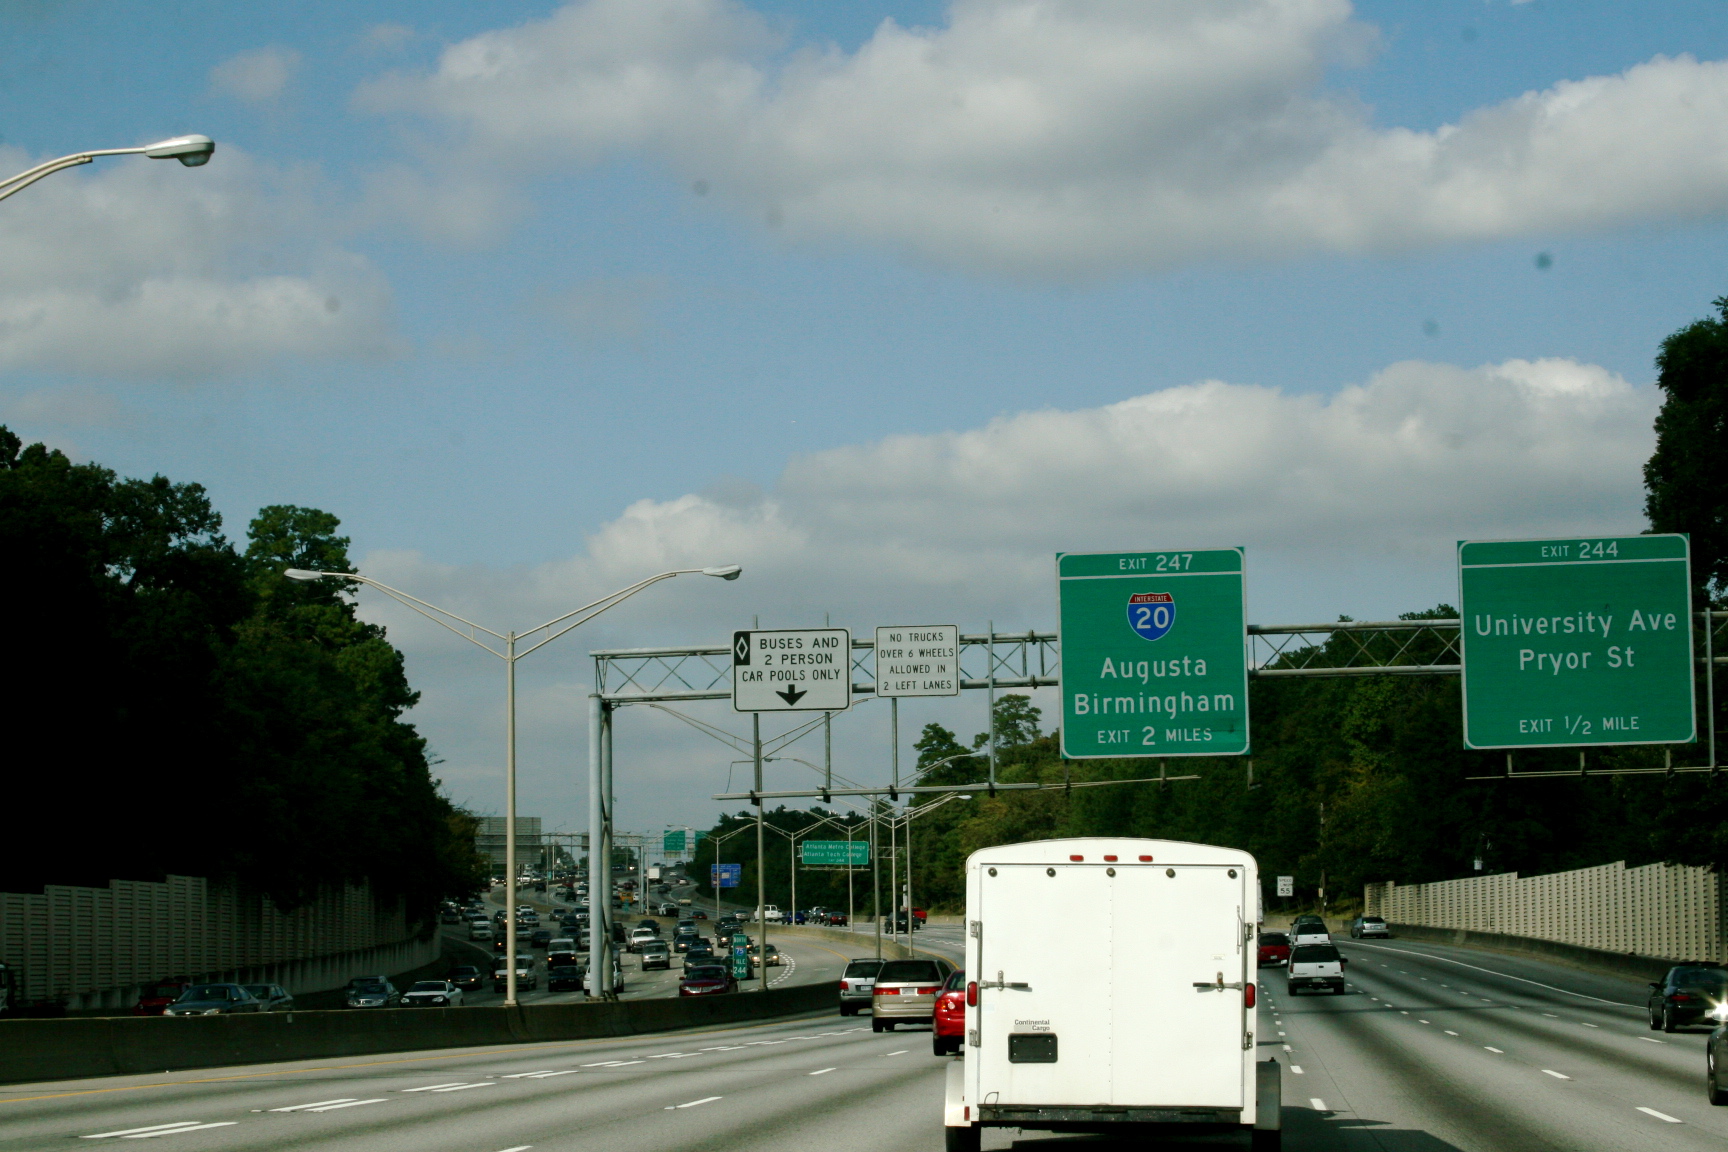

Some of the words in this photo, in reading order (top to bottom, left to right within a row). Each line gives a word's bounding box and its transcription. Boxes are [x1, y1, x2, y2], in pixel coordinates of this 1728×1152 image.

[1542, 546, 1569, 557] EXIT
[1579, 542, 1619, 558] 244
[1119, 558, 1147, 570] EXIT
[1156, 554, 1193, 571] 247
[1136, 606, 1169, 629] 20
[1475, 611, 1613, 638] University
[1629, 609, 1676, 631] Ave
[760, 639, 803, 649] BUSES
[813, 637, 839, 648] AND
[890, 633, 902, 642] NO
[909, 632, 943, 642] TRUCKS
[765, 655, 772, 665] 2
[782, 654, 832, 665] PERSON
[880, 649, 903, 658] OVER
[908, 649, 914, 658] 6
[919, 648, 954, 657] WHEELS
[1520, 649, 1592, 675] Pryor
[1607, 646, 1634, 668] St
[742, 671, 763, 681] CAR
[770, 670, 806, 681] POOLS
[813, 669, 840, 680] ONLY
[889, 665, 930, 674] ALLOWED
[938, 664, 946, 673] IN
[1100, 655, 1206, 684] Augusta
[884, 681, 888, 690] 2
[896, 681, 916, 690] LEFT
[924, 680, 952, 689] LANES
[1075, 691, 1234, 719] Birmingham
[1520, 719, 1553, 733] EXIT
[1565, 715, 1591, 735] 1/2
[1603, 717, 1639, 730] MILE
[1098, 730, 1130, 743] EXIT
[1142, 726, 1156, 745] 2
[1166, 728, 1213, 741] MILES
